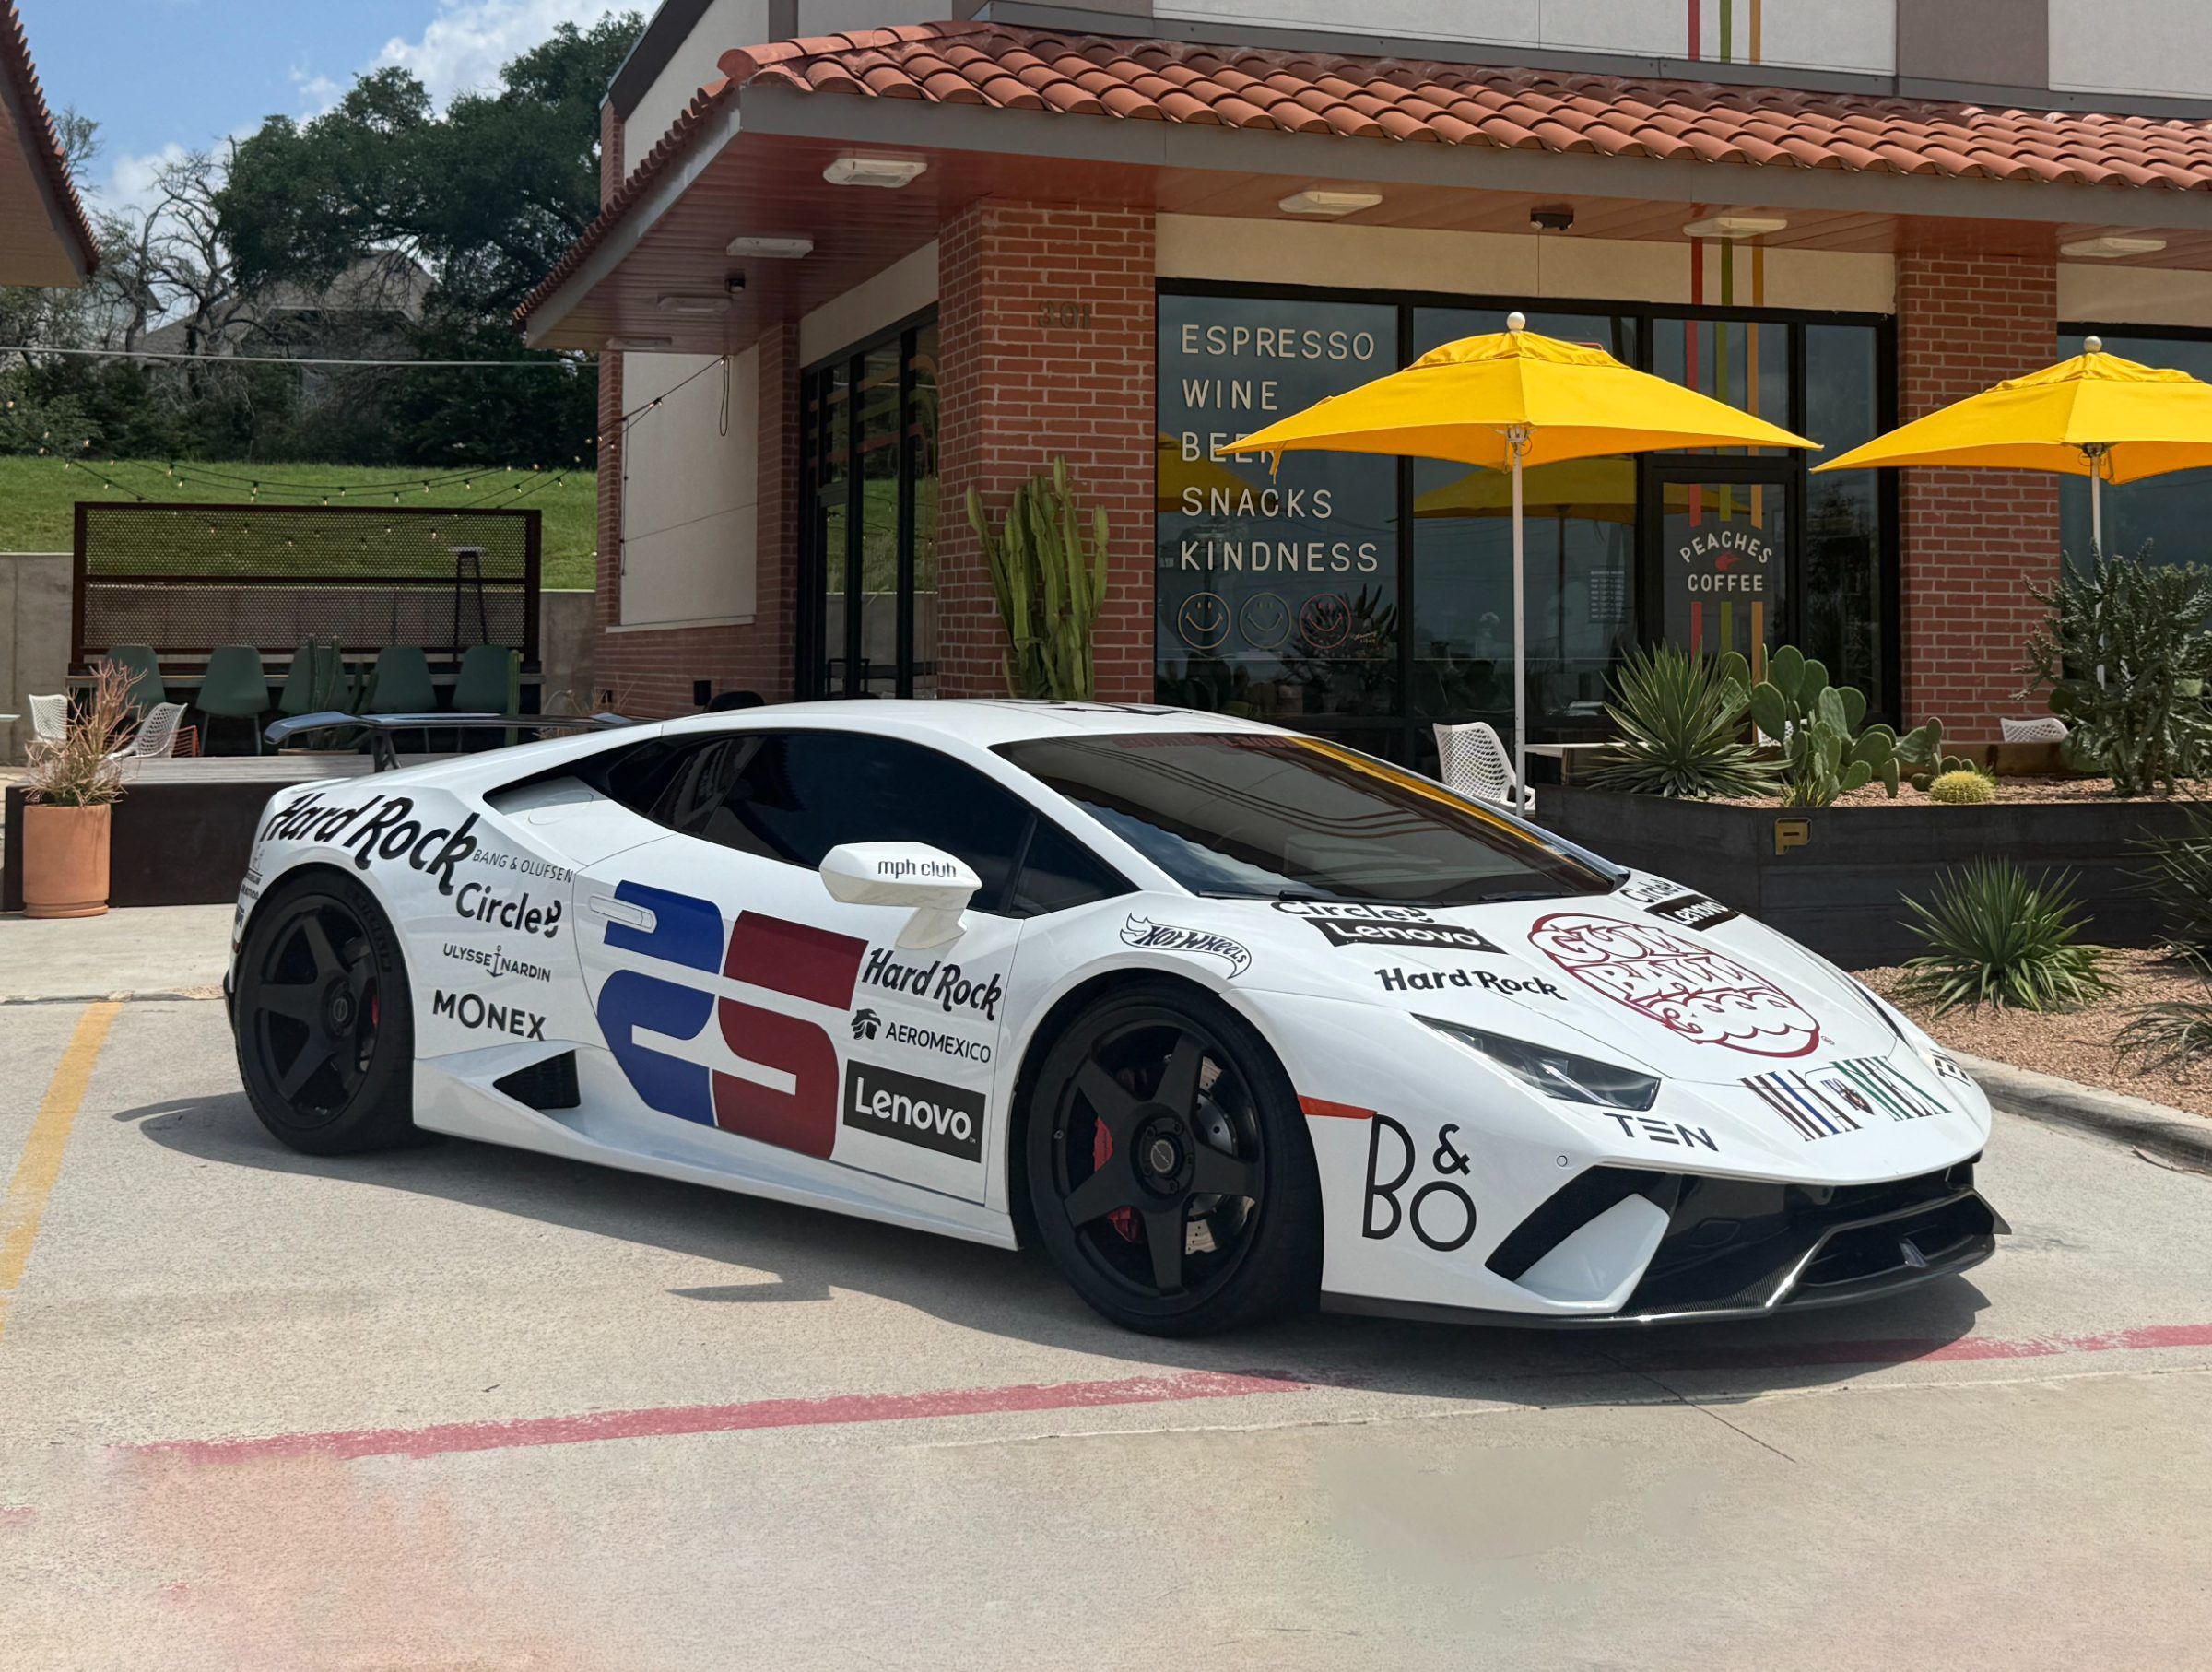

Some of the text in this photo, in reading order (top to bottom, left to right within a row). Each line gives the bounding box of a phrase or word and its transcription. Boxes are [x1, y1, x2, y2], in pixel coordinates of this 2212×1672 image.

[1182, 324, 1374, 360] ESPRESSO
[1182, 378, 1278, 411] WINE
[1182, 487, 1333, 518] SNACKS
[1181, 540, 1378, 572] KINDNESS
[1679, 531, 1771, 563] PEACHES
[1688, 574, 1763, 592] COFFEE
[259, 793, 480, 895] Hard Rock
[473, 849, 573, 884] BANG & OLUFSEN
[877, 858, 916, 879] mph
[1658, 901, 1729, 925] Lenovo
[1326, 922, 1481, 947] Lenovo
[442, 943, 552, 983] ULYSSE NARDIN
[862, 948, 1003, 1021] Hard Rock
[1374, 967, 1569, 1001] Hard Rock
[432, 989, 547, 1042] MONEX
[885, 1022, 992, 1064] AEROMEXICO
[855, 1077, 972, 1141] Lenovo
[1602, 1112, 1720, 1153] TEN
